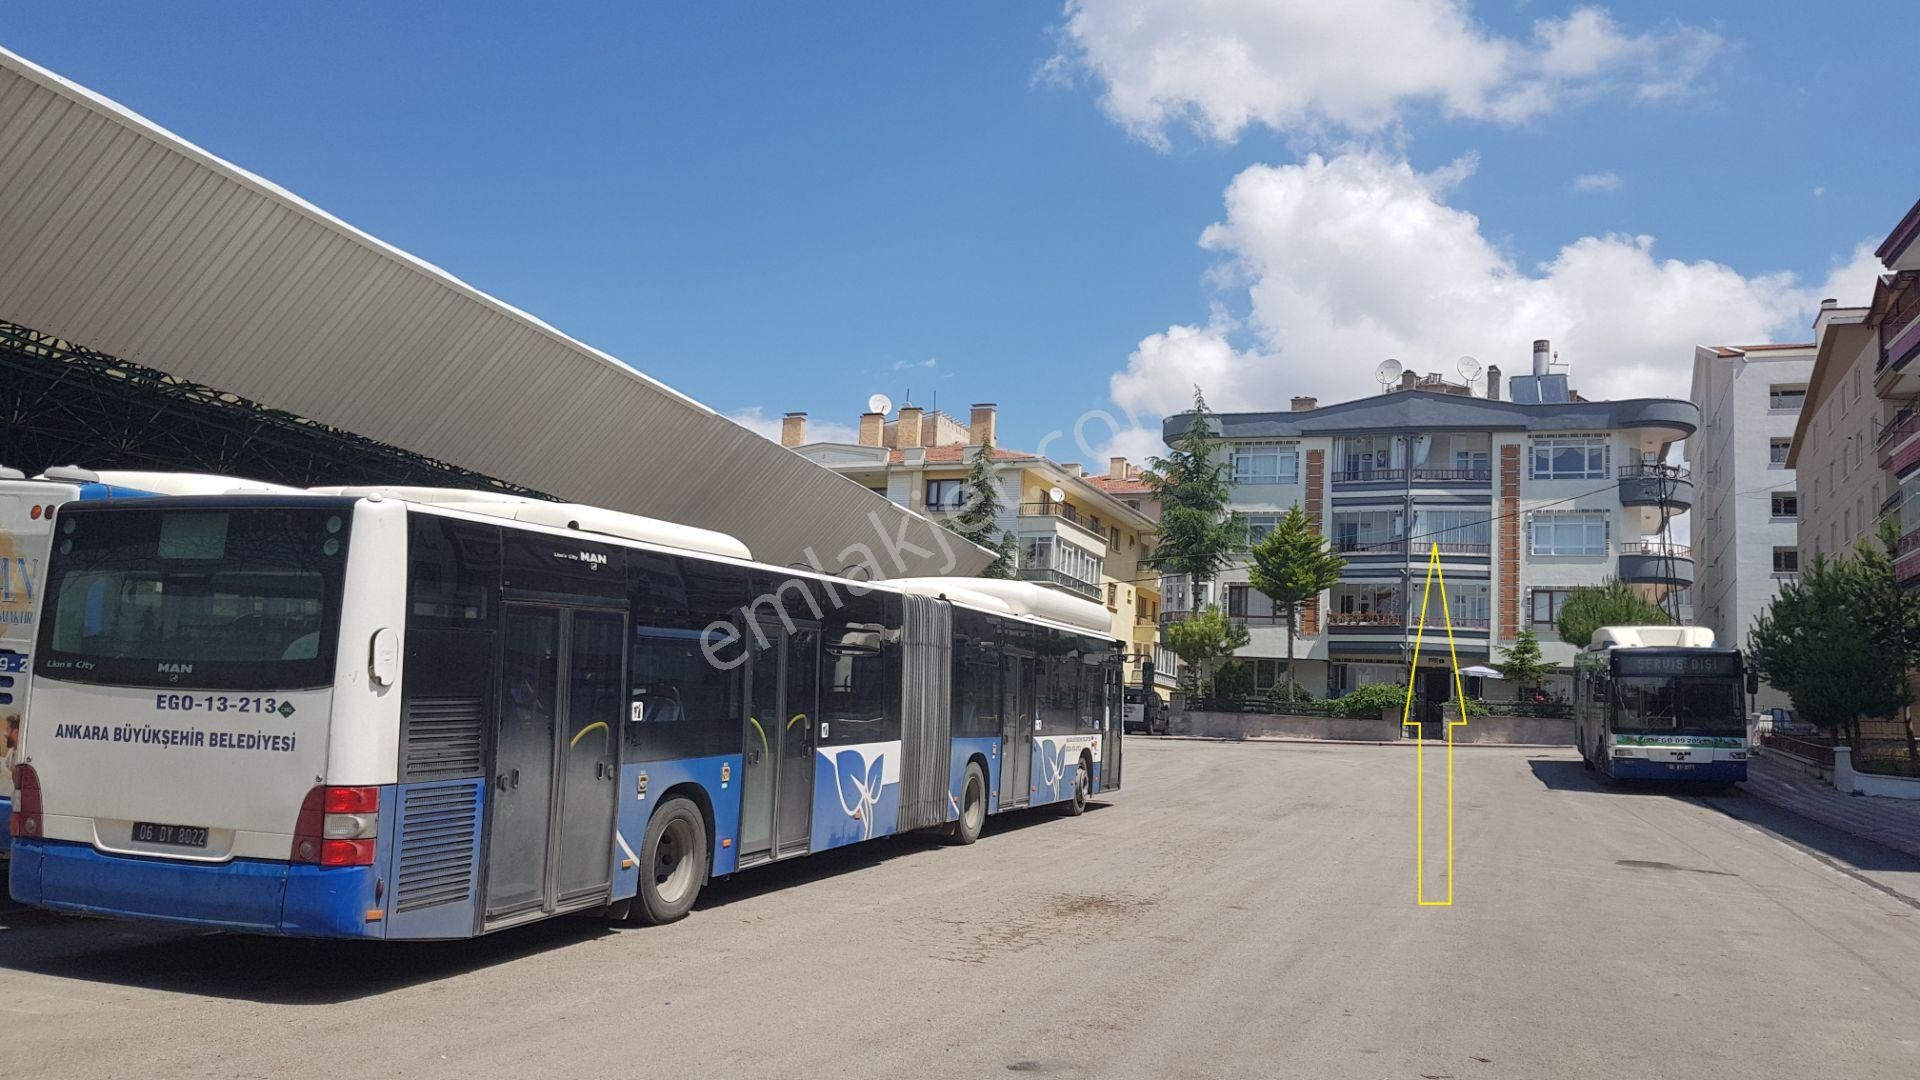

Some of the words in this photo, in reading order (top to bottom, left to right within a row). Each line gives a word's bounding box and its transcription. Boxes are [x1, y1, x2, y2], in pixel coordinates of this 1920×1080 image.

[580, 551, 607, 564] MAN
[47, 660, 72, 668] Lion's
[75, 660, 96, 671] City
[157, 663, 193, 674] MAN
[156, 694, 276, 714] EGO-13-213
[55, 723, 109, 742] ANKARA
[113, 723, 204, 749] BÜYÜKŞEHİR
[209, 730, 296, 752] BELEDİYESİ
[140, 824, 153, 840] 06
[160, 826, 174, 842] DY
[178, 828, 205, 845] 8022
